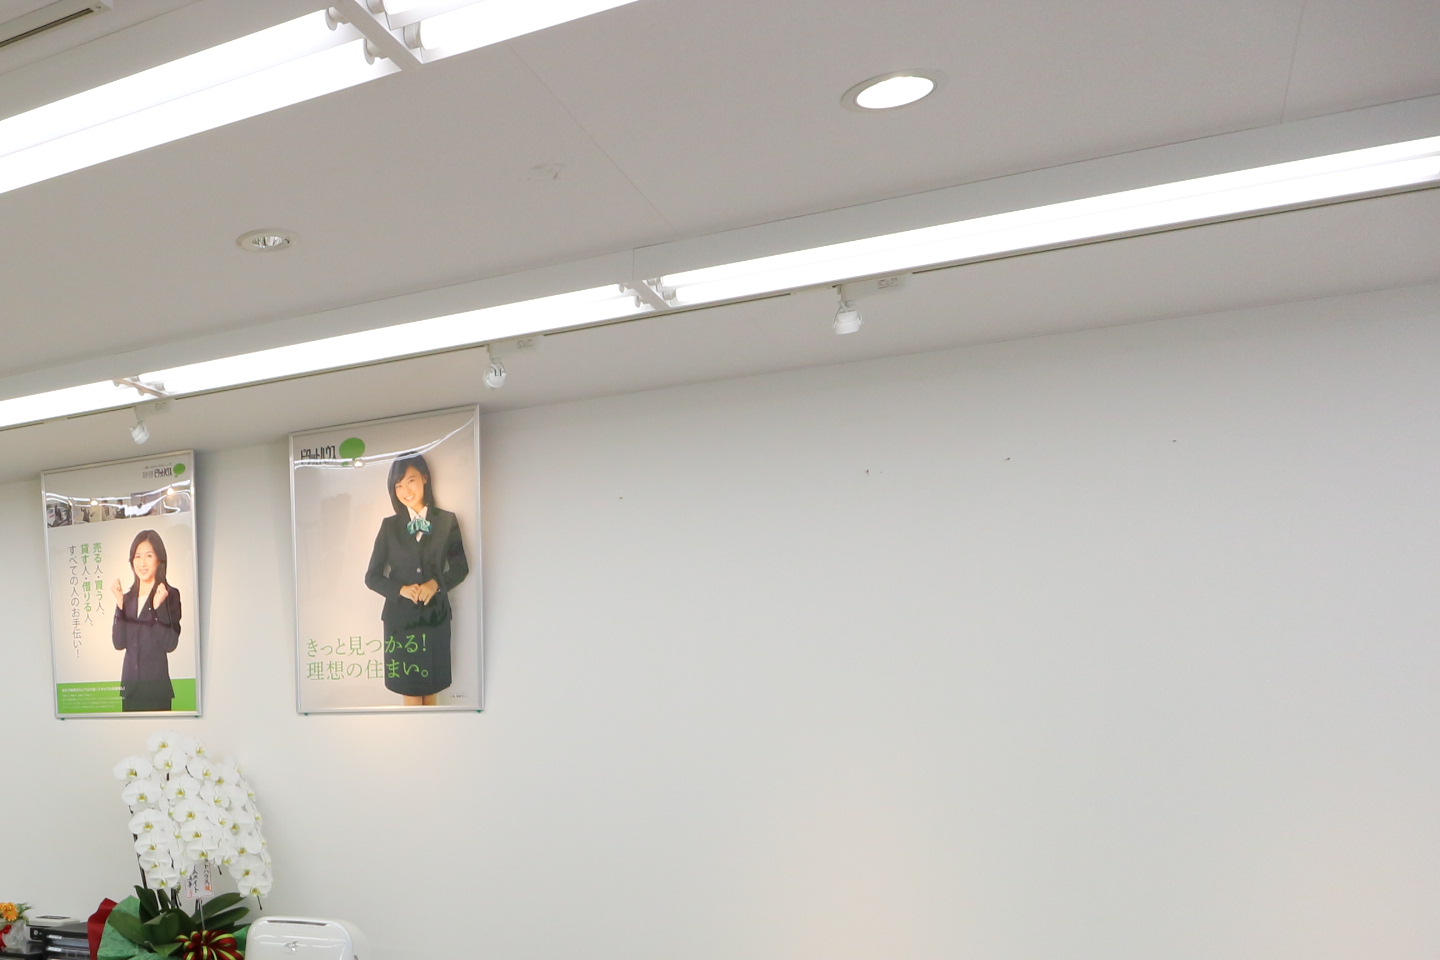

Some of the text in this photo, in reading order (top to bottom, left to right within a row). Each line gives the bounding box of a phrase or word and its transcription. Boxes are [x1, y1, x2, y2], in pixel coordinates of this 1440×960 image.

[80, 543, 93, 626] 貸す人・借りる人、
[92, 542, 105, 616] 売る人・買う人、
[306, 659, 429, 680] 理想の住まい。
